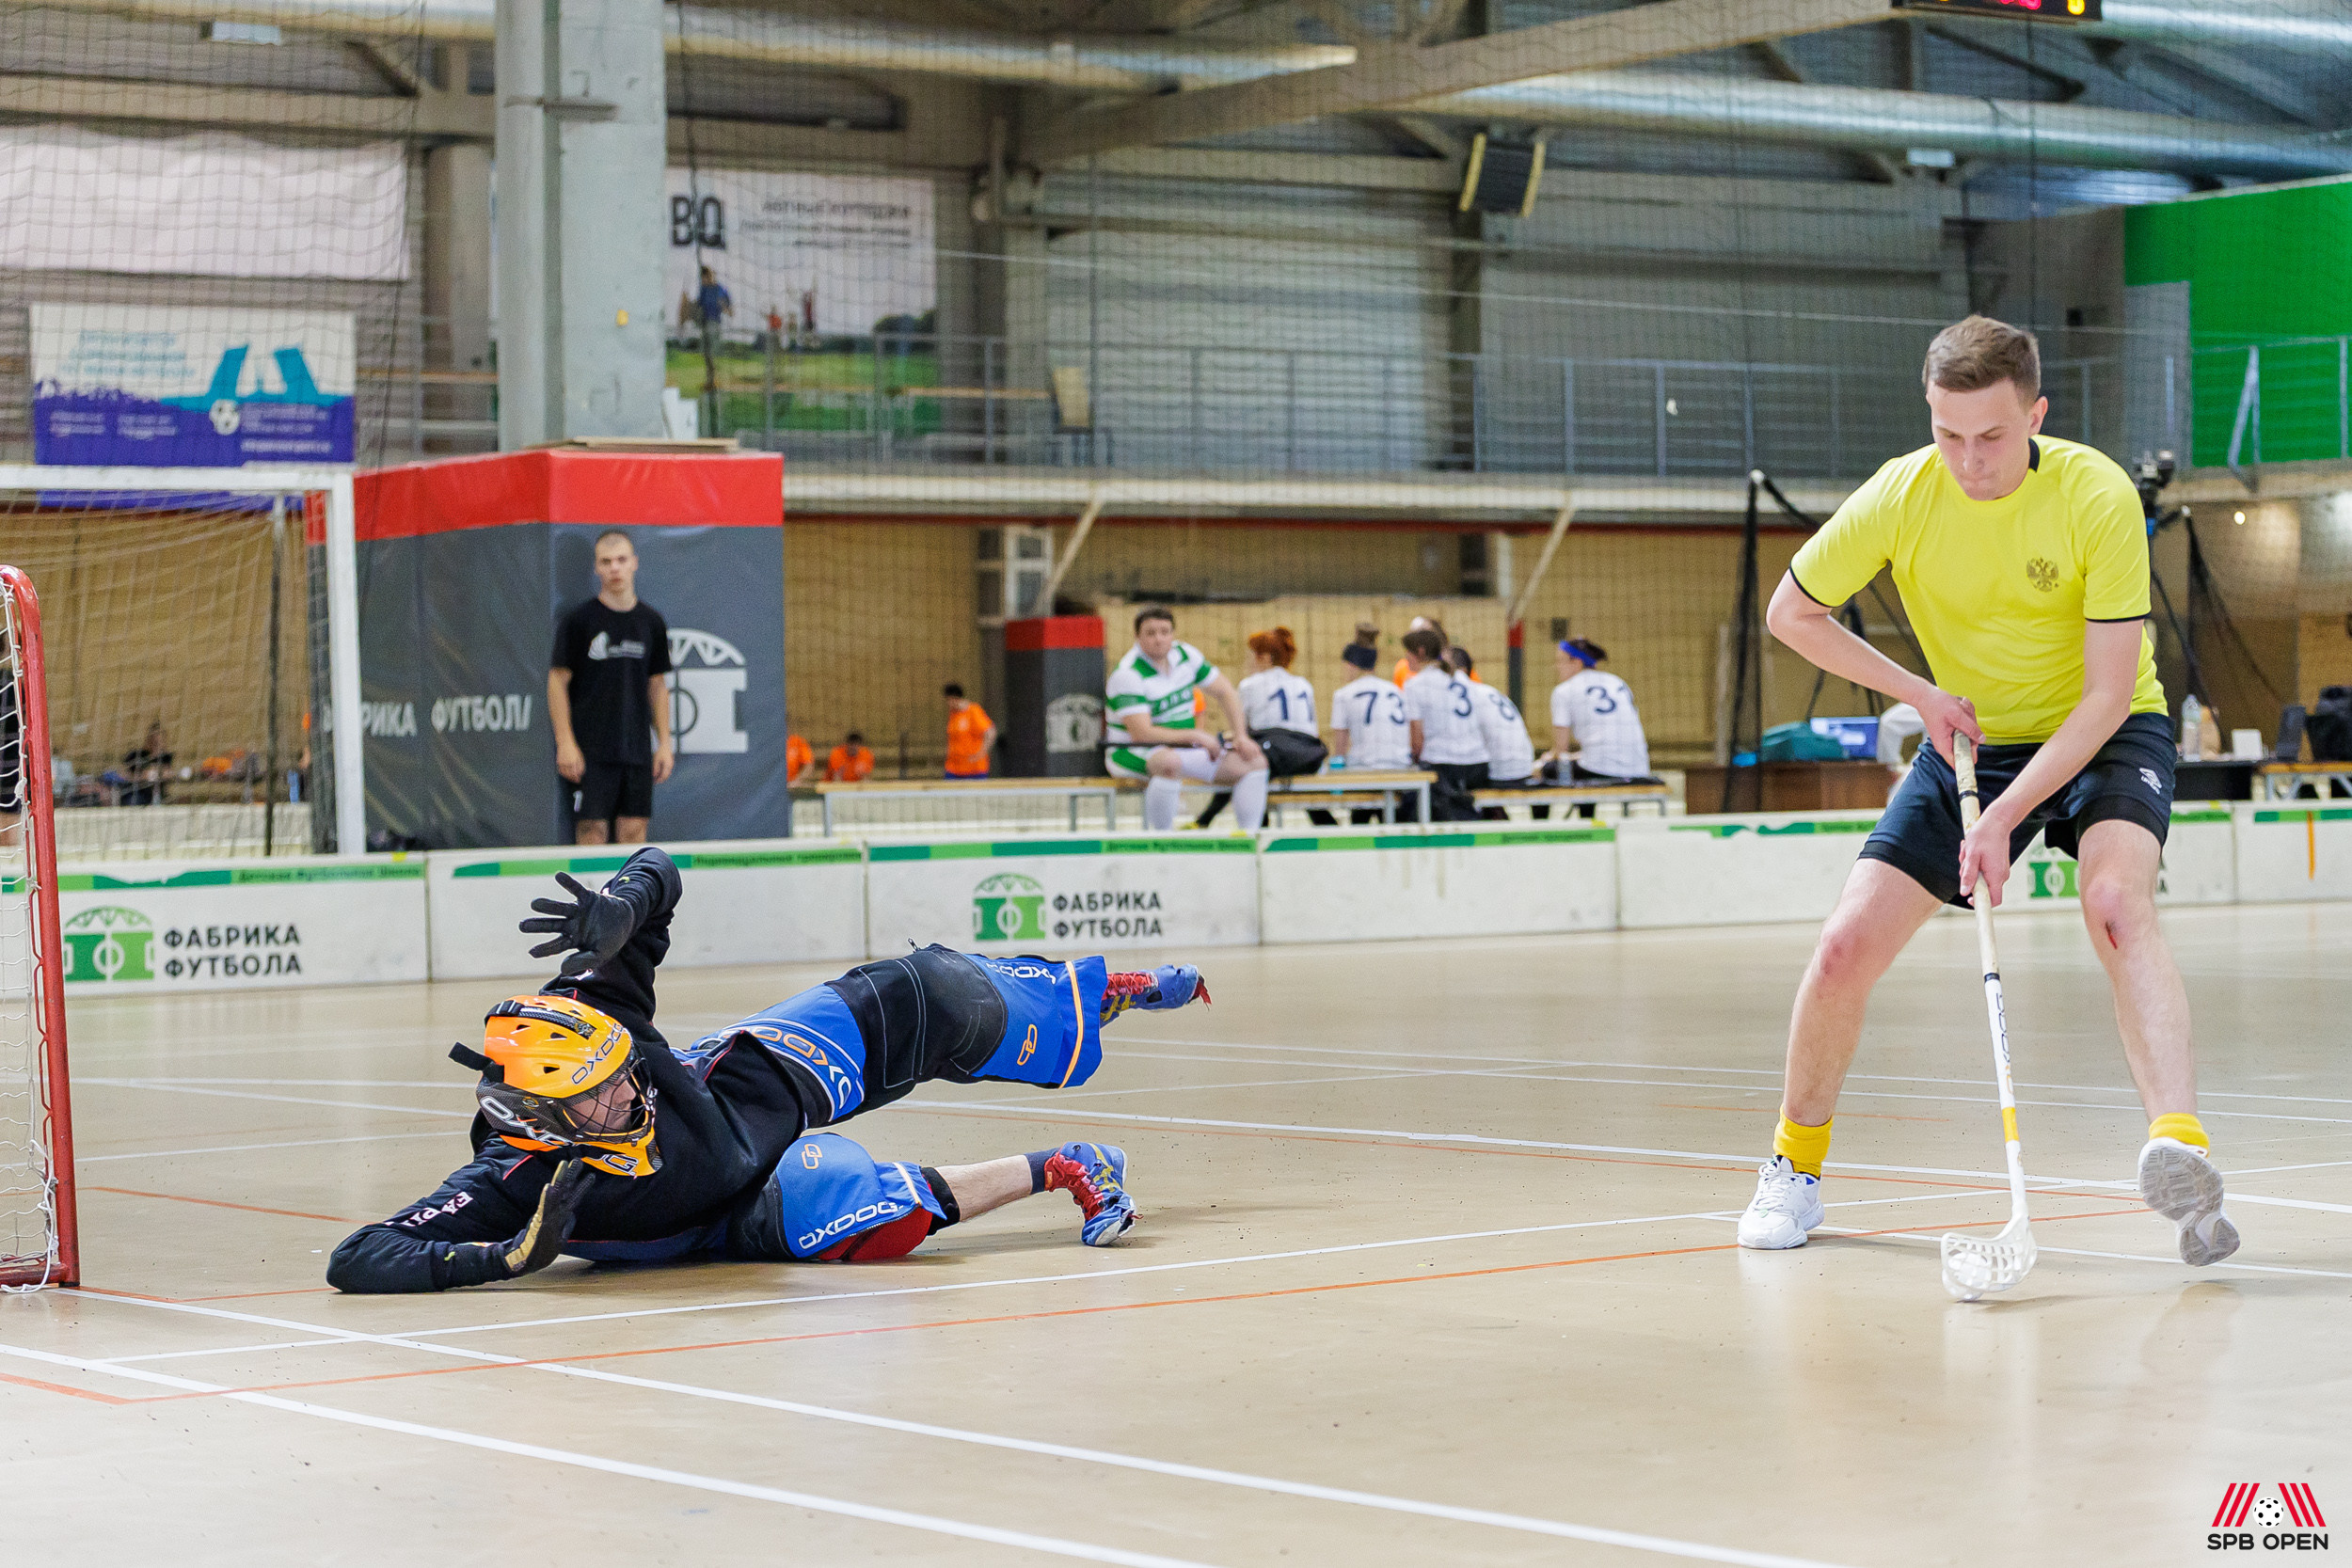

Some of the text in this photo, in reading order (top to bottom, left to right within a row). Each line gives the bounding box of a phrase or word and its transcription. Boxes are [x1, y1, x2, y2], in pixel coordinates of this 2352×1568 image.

[1269, 688, 1314, 722] 11
[1355, 691, 1406, 724] 73
[1449, 682, 1471, 717] 3
[1053, 891, 1162, 914] ФАБРИКА
[165, 924, 301, 951] ФАБРИКА
[1053, 917, 1163, 939] ФУТБОЛА
[165, 953, 302, 979] ФУТБОЛА
[723, 1026, 851, 1109] OXDO
[480, 1096, 640, 1176] OXDG
[799, 1202, 899, 1249] OXDOG
